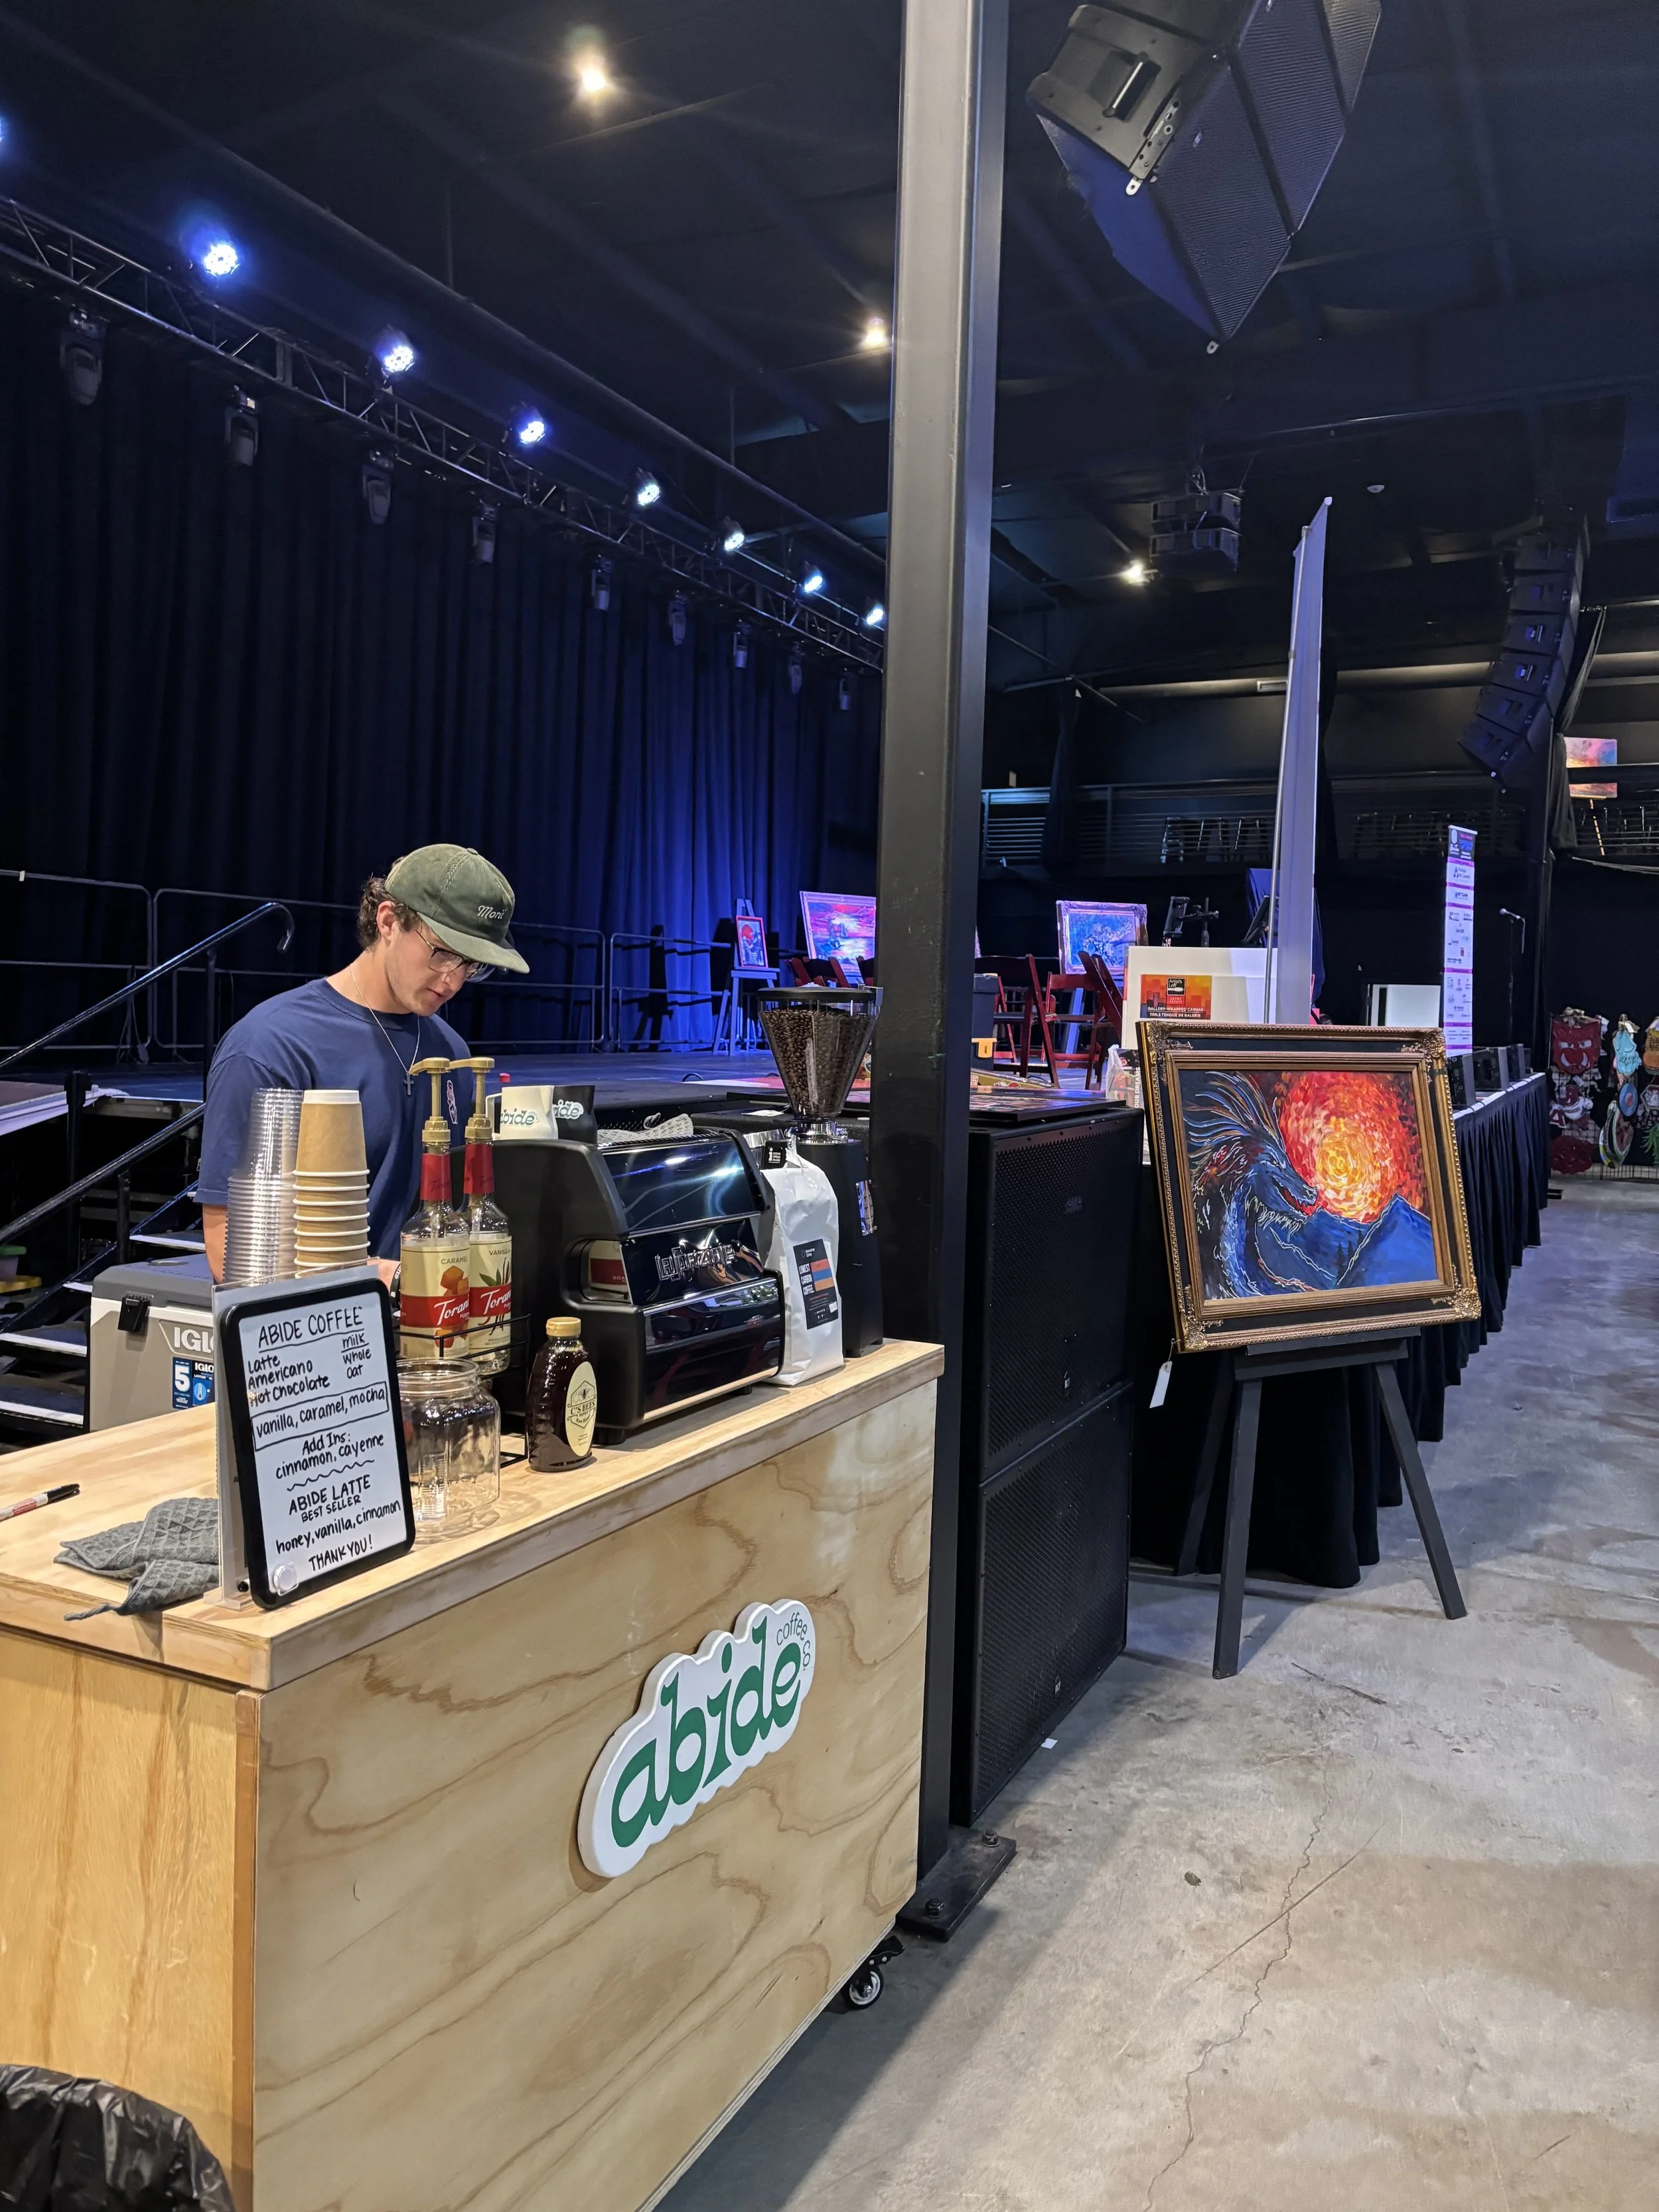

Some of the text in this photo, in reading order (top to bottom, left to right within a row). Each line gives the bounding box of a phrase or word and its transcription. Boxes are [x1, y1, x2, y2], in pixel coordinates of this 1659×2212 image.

[174, 1327, 214, 1354] IGL
[259, 1306, 363, 1348] ABIDE COFFEE
[175, 1364, 191, 1392] 5
[248, 1355, 281, 1374] Latte
[248, 1360, 313, 1390] Americano
[256, 1388, 386, 1438] vanilla, caramel, mocha
[570, 1400, 595, 1416] C'S BEES
[275, 1434, 384, 1479] cinnamon, cayenne
[302, 1436, 325, 1456] Add
[289, 1474, 371, 1515] ABIDE LATTE
[301, 1495, 362, 1523] BEST SELLER
[308, 1545, 346, 1572] THANK
[776, 1611, 808, 1645] coffee
[611, 1615, 801, 1848] abide
